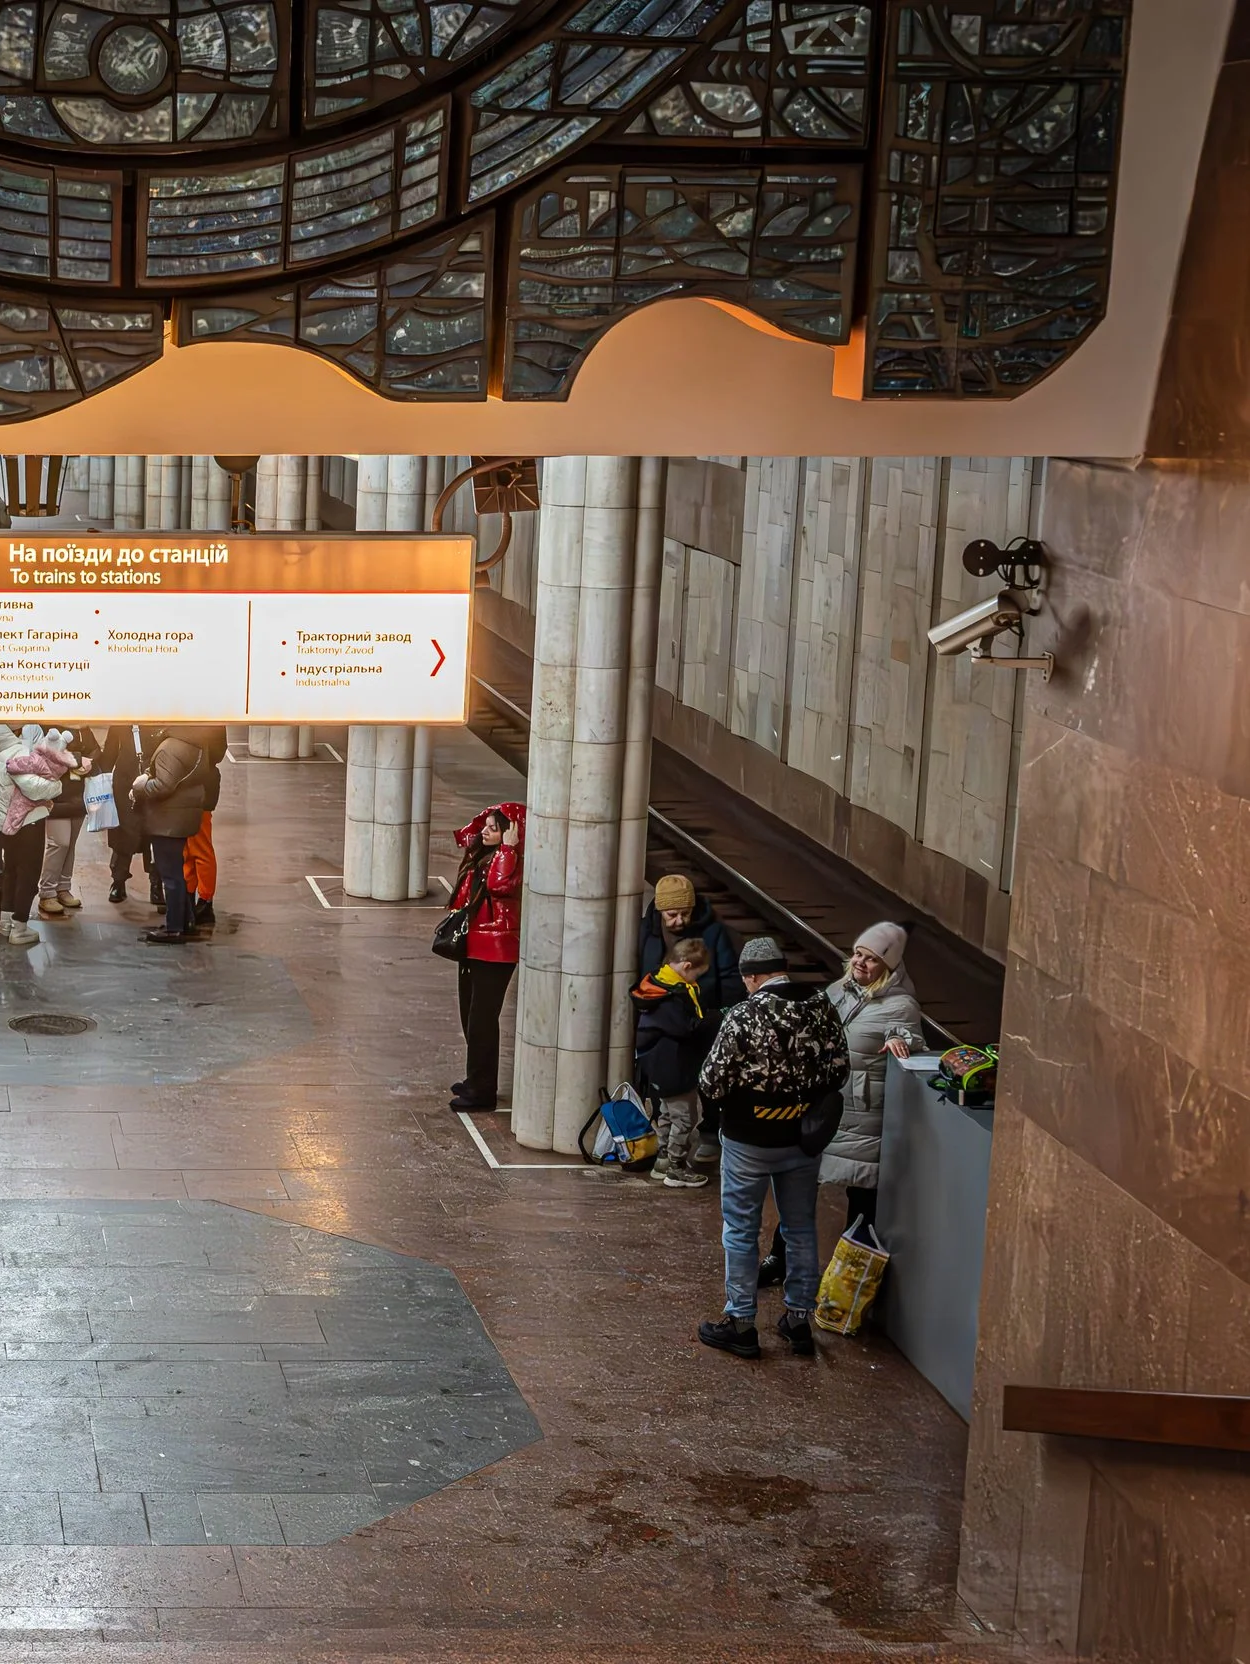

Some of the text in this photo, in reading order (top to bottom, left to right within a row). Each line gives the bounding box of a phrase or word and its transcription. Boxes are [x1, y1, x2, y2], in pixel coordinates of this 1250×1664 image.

[10, 544, 228, 567] На поїзди до станцій
[10, 568, 161, 585] To trains to stations
[27, 629, 79, 642] Гагаріна
[108, 629, 194, 643] Холодна гора
[295, 630, 412, 644] Тракторний завод
[107, 643, 179, 653] Kholodna Hora
[343, 645, 375, 655] Zavod
[17, 657, 90, 671] Конституції
[294, 664, 382, 676] Індустріальна
[52, 691, 91, 703] ринок
[16, 704, 46, 715] Rynok
